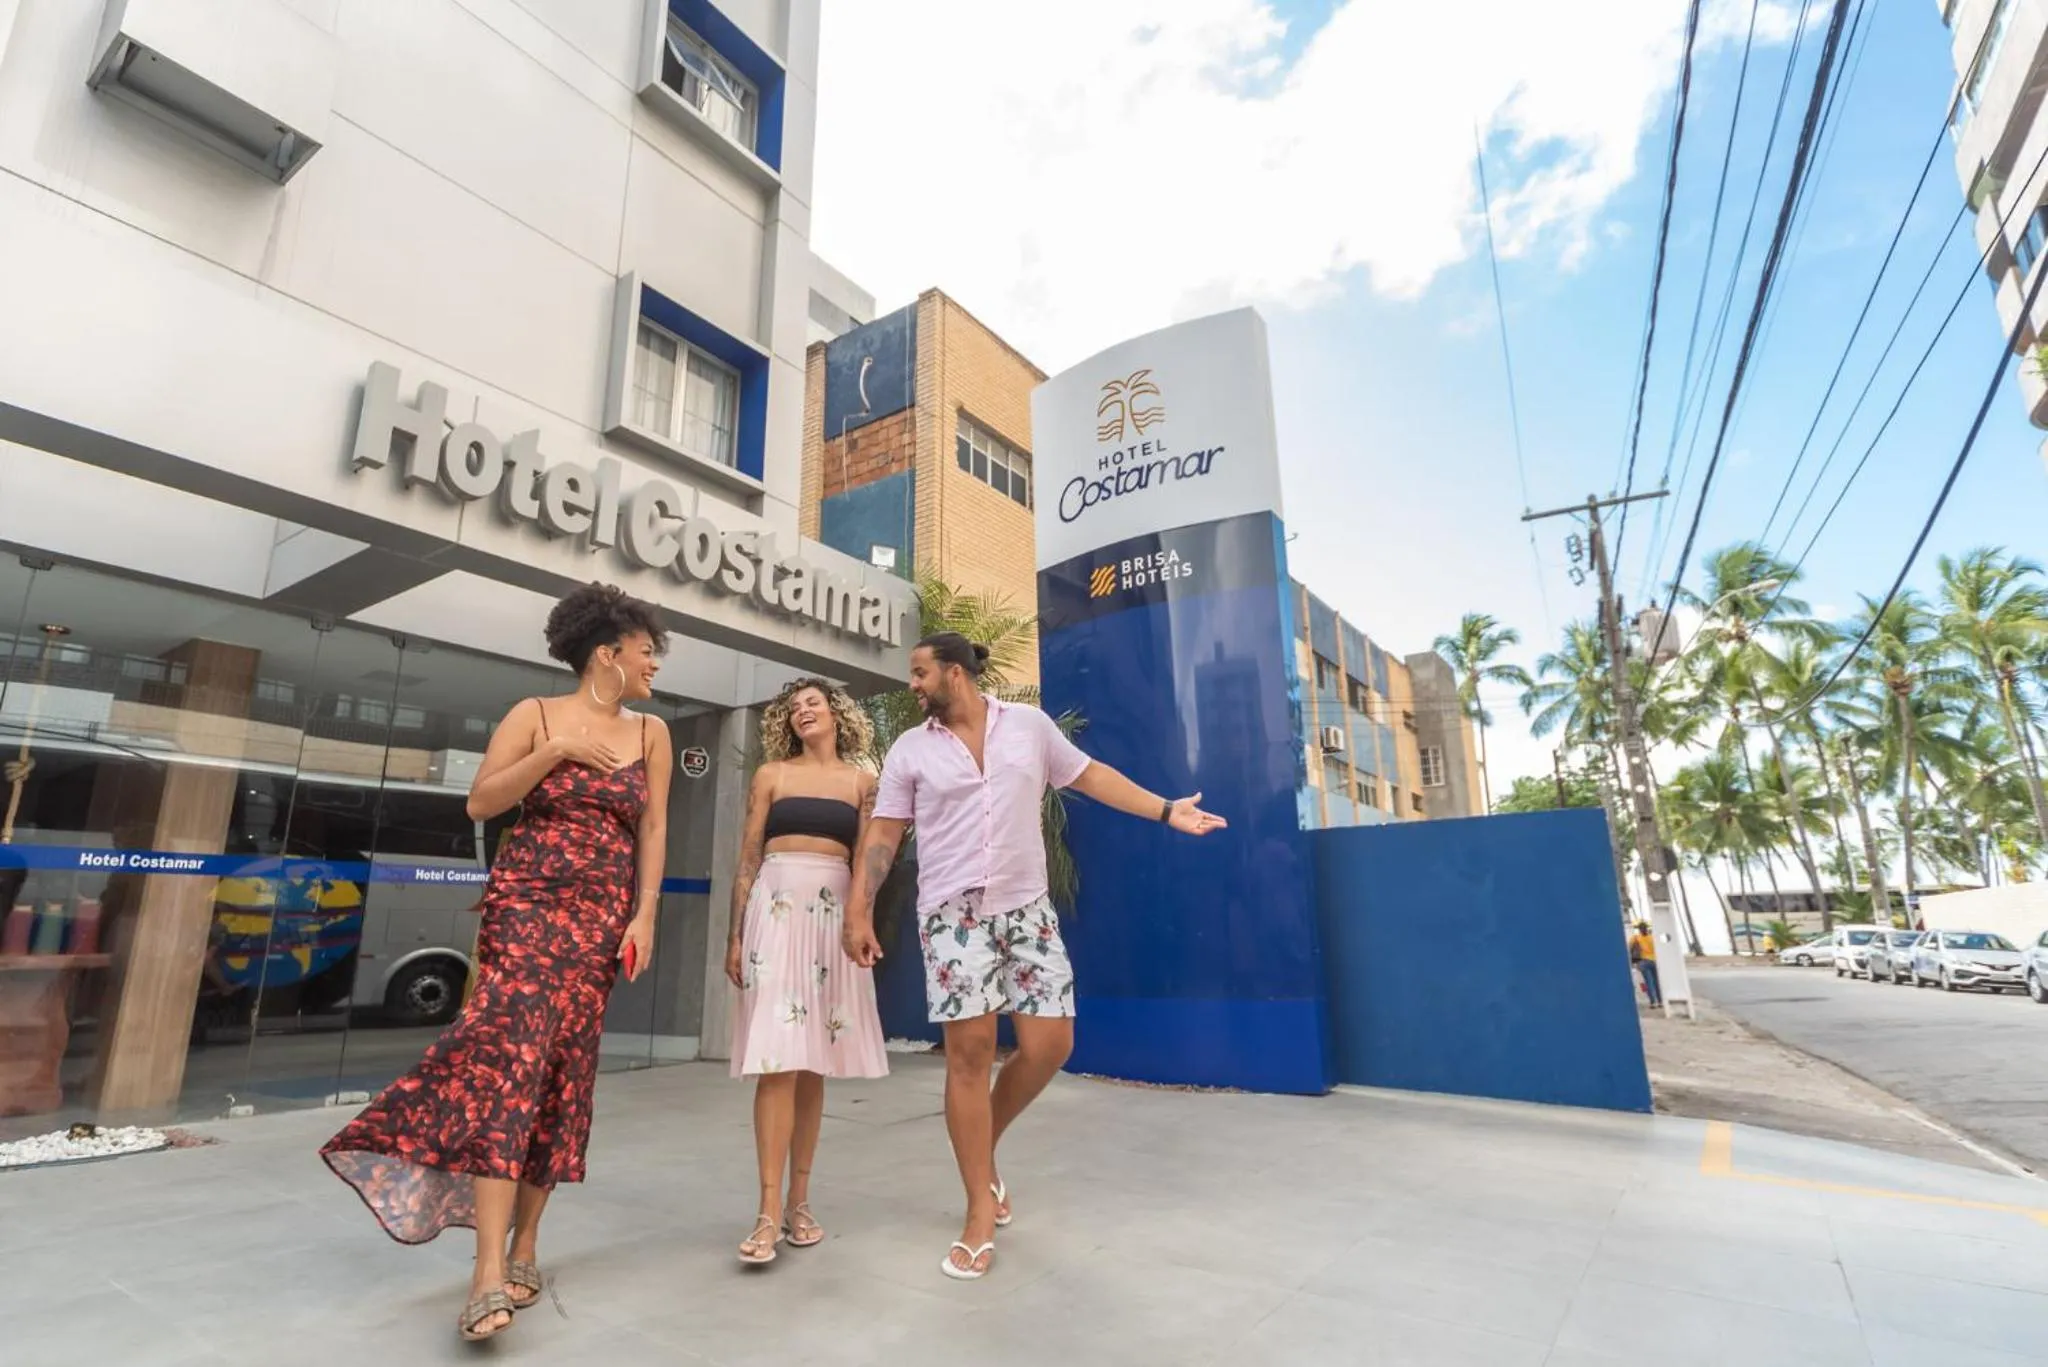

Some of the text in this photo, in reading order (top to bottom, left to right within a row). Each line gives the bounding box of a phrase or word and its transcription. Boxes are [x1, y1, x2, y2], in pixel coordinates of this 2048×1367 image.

[1098, 439, 1167, 471] HOTEL
[1059, 446, 1225, 523] Costamar
[353, 360, 906, 647] Hotel Costamar
[1121, 549, 1180, 575] BRISA
[1122, 562, 1193, 590] HOTÉIS
[79, 853, 204, 870] Hotel Costamar
[415, 869, 445, 881] Hotel
